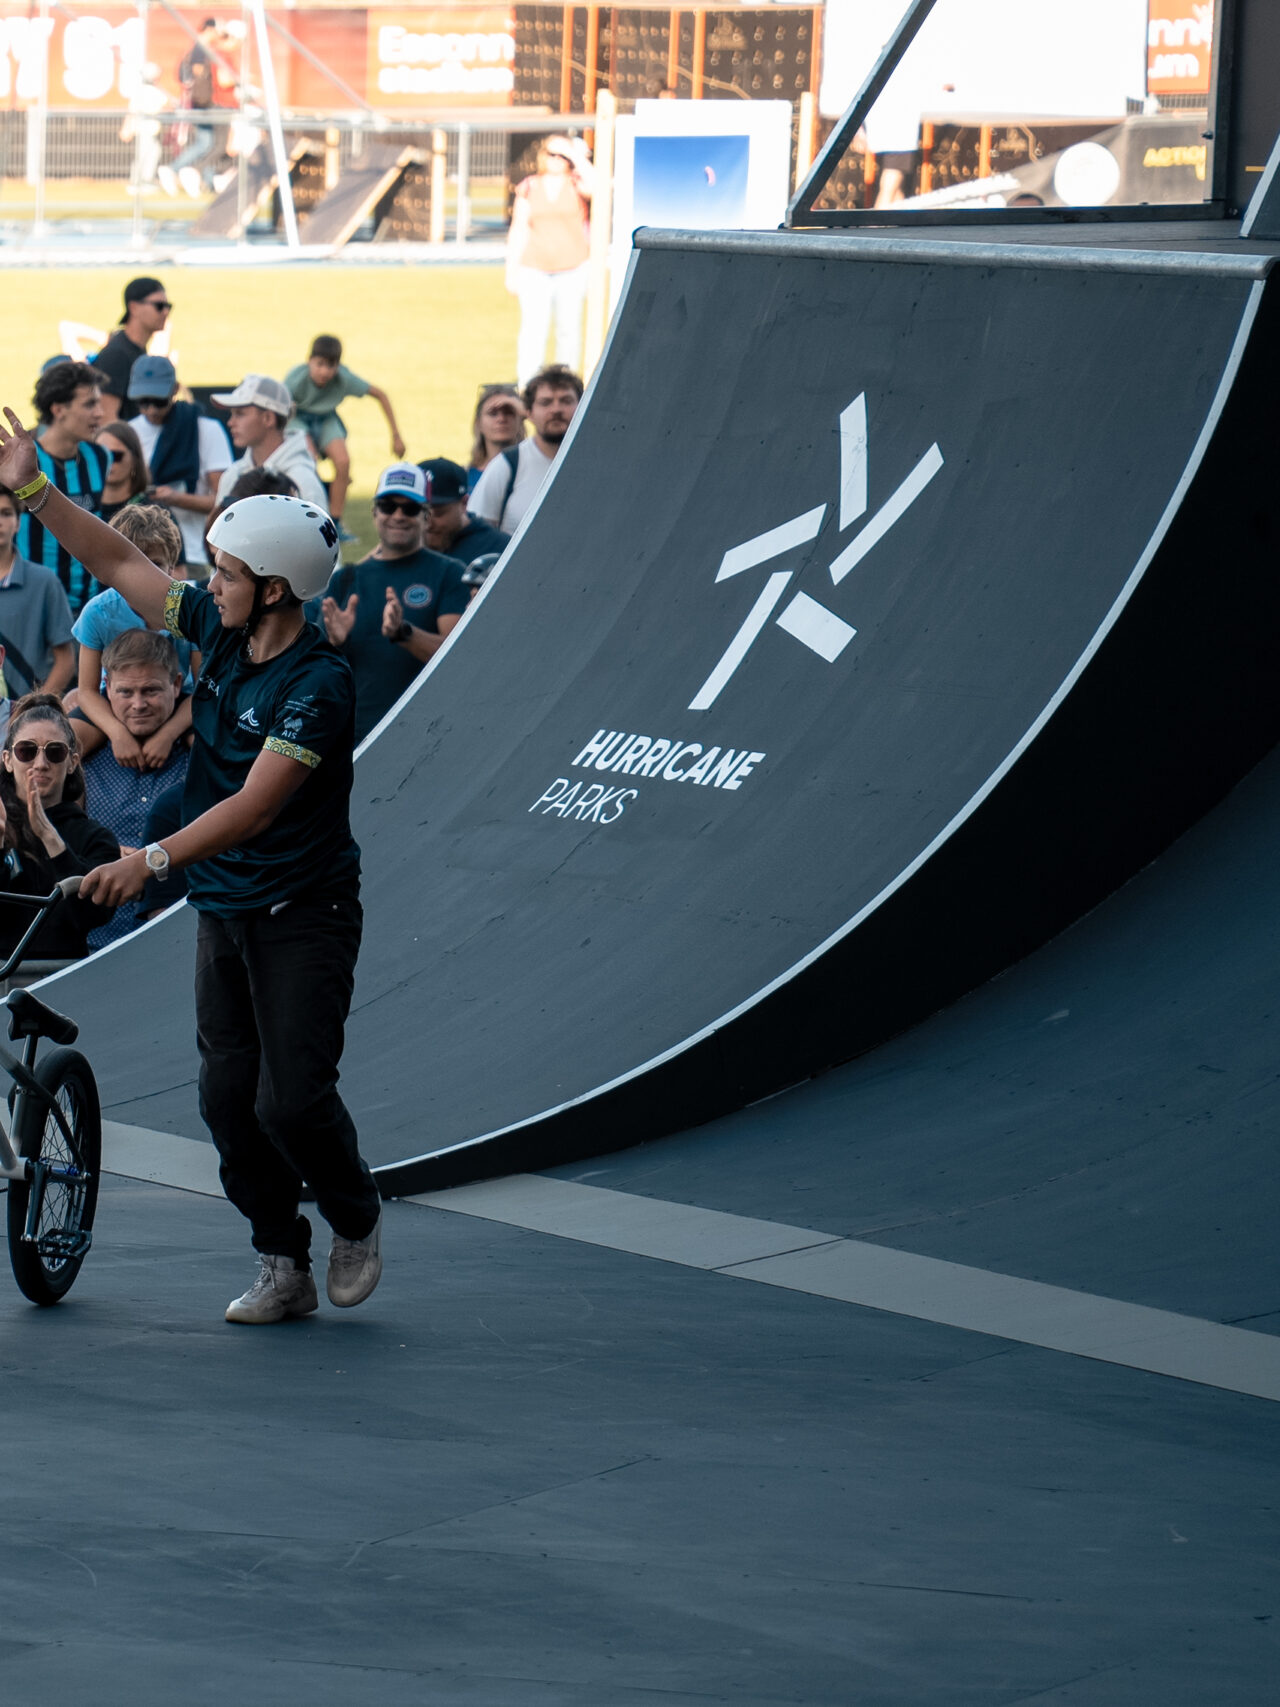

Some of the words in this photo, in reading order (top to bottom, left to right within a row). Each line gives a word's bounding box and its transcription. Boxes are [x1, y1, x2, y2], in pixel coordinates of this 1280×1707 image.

[281, 729, 298, 740] AIS
[571, 729, 767, 791] HURRICANE
[528, 777, 639, 825] PARKS
